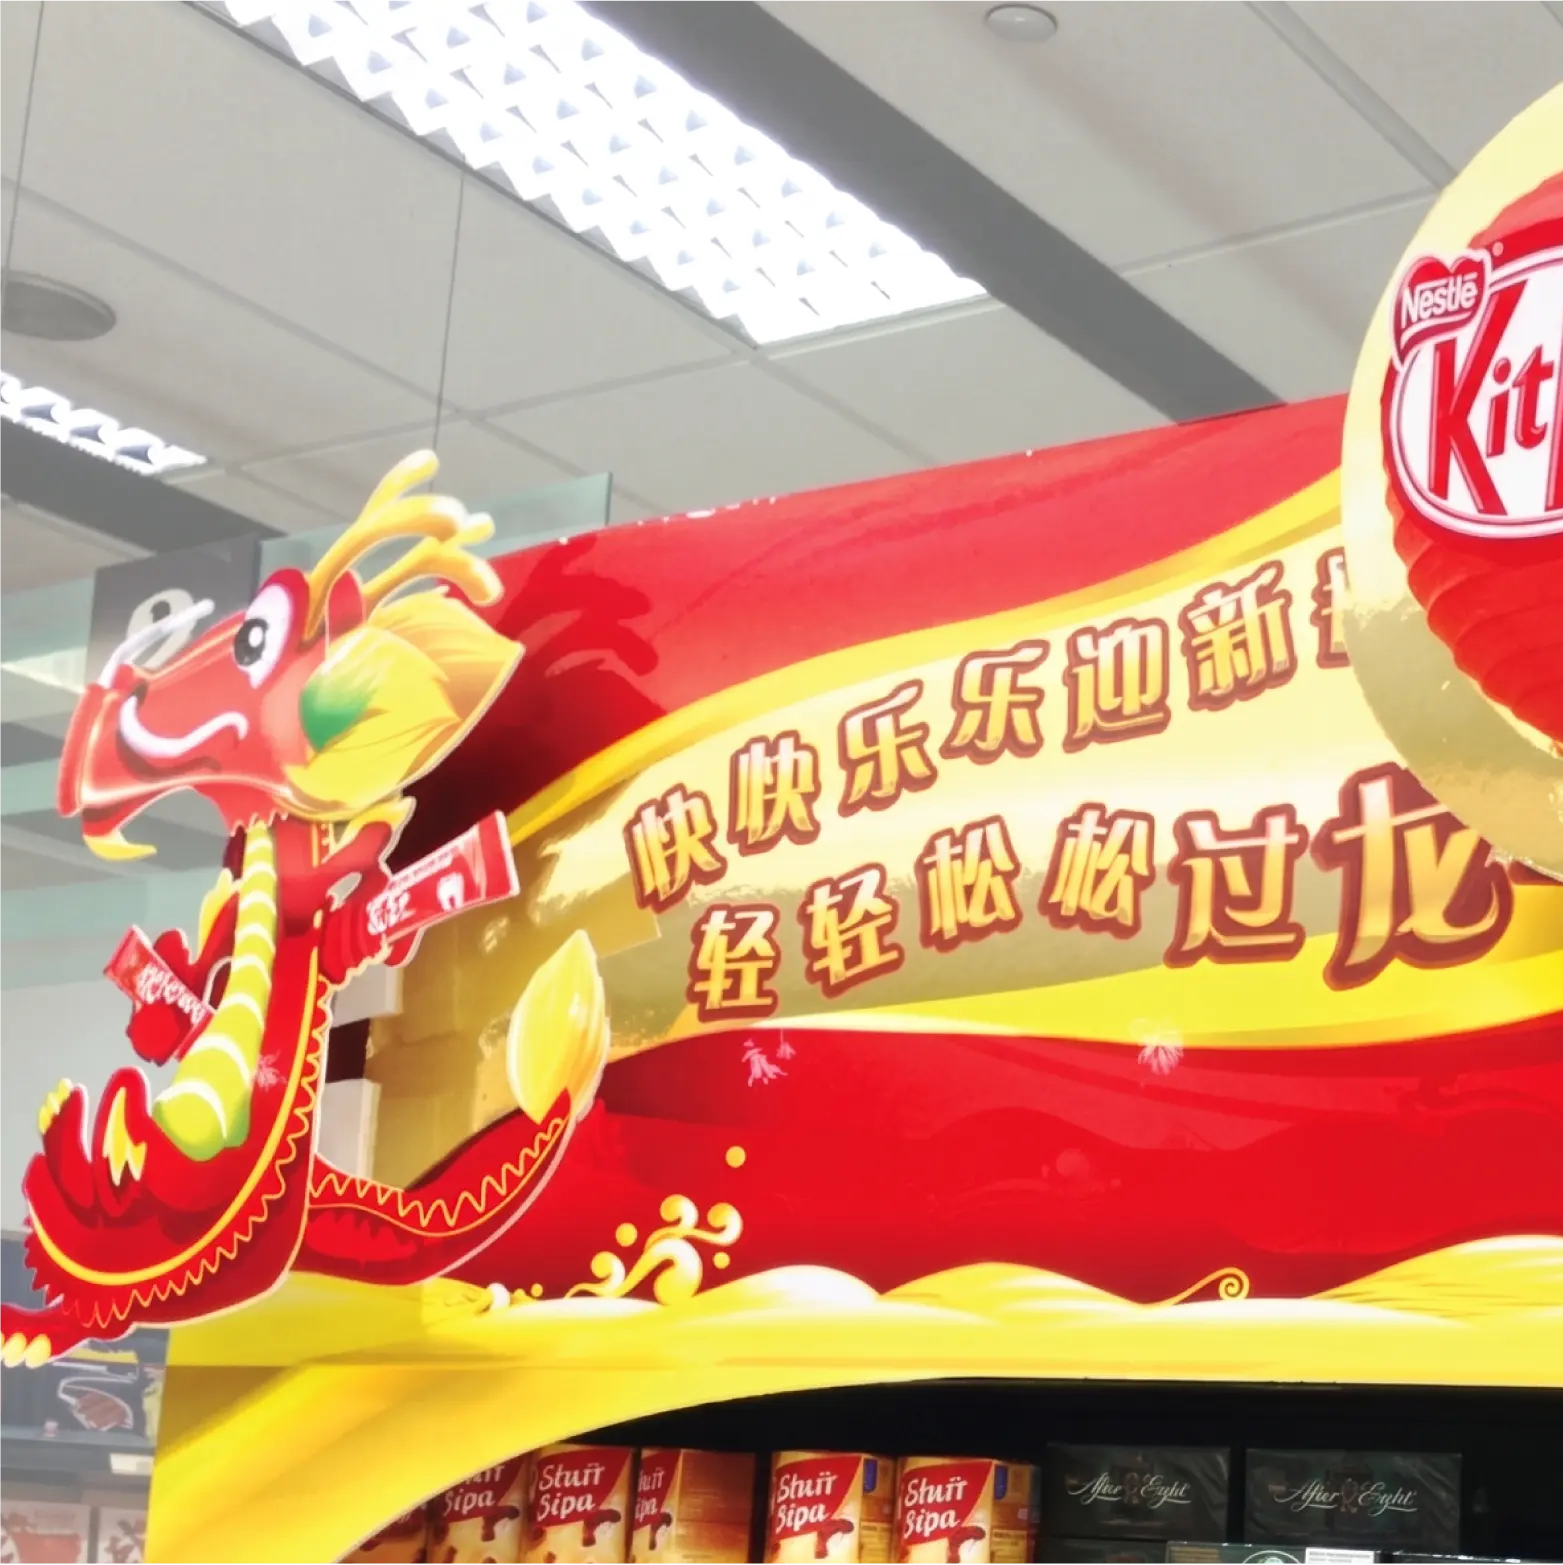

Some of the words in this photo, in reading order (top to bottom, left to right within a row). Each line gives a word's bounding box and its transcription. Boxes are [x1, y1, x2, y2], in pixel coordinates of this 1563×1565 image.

[624, 546, 1346, 908] 快快乐乐迎新
[1069, 1472, 1121, 1506] After
[1141, 1474, 1191, 1508] Eight
[1274, 1480, 1339, 1513] After
[1359, 1482, 1417, 1517] Eight
